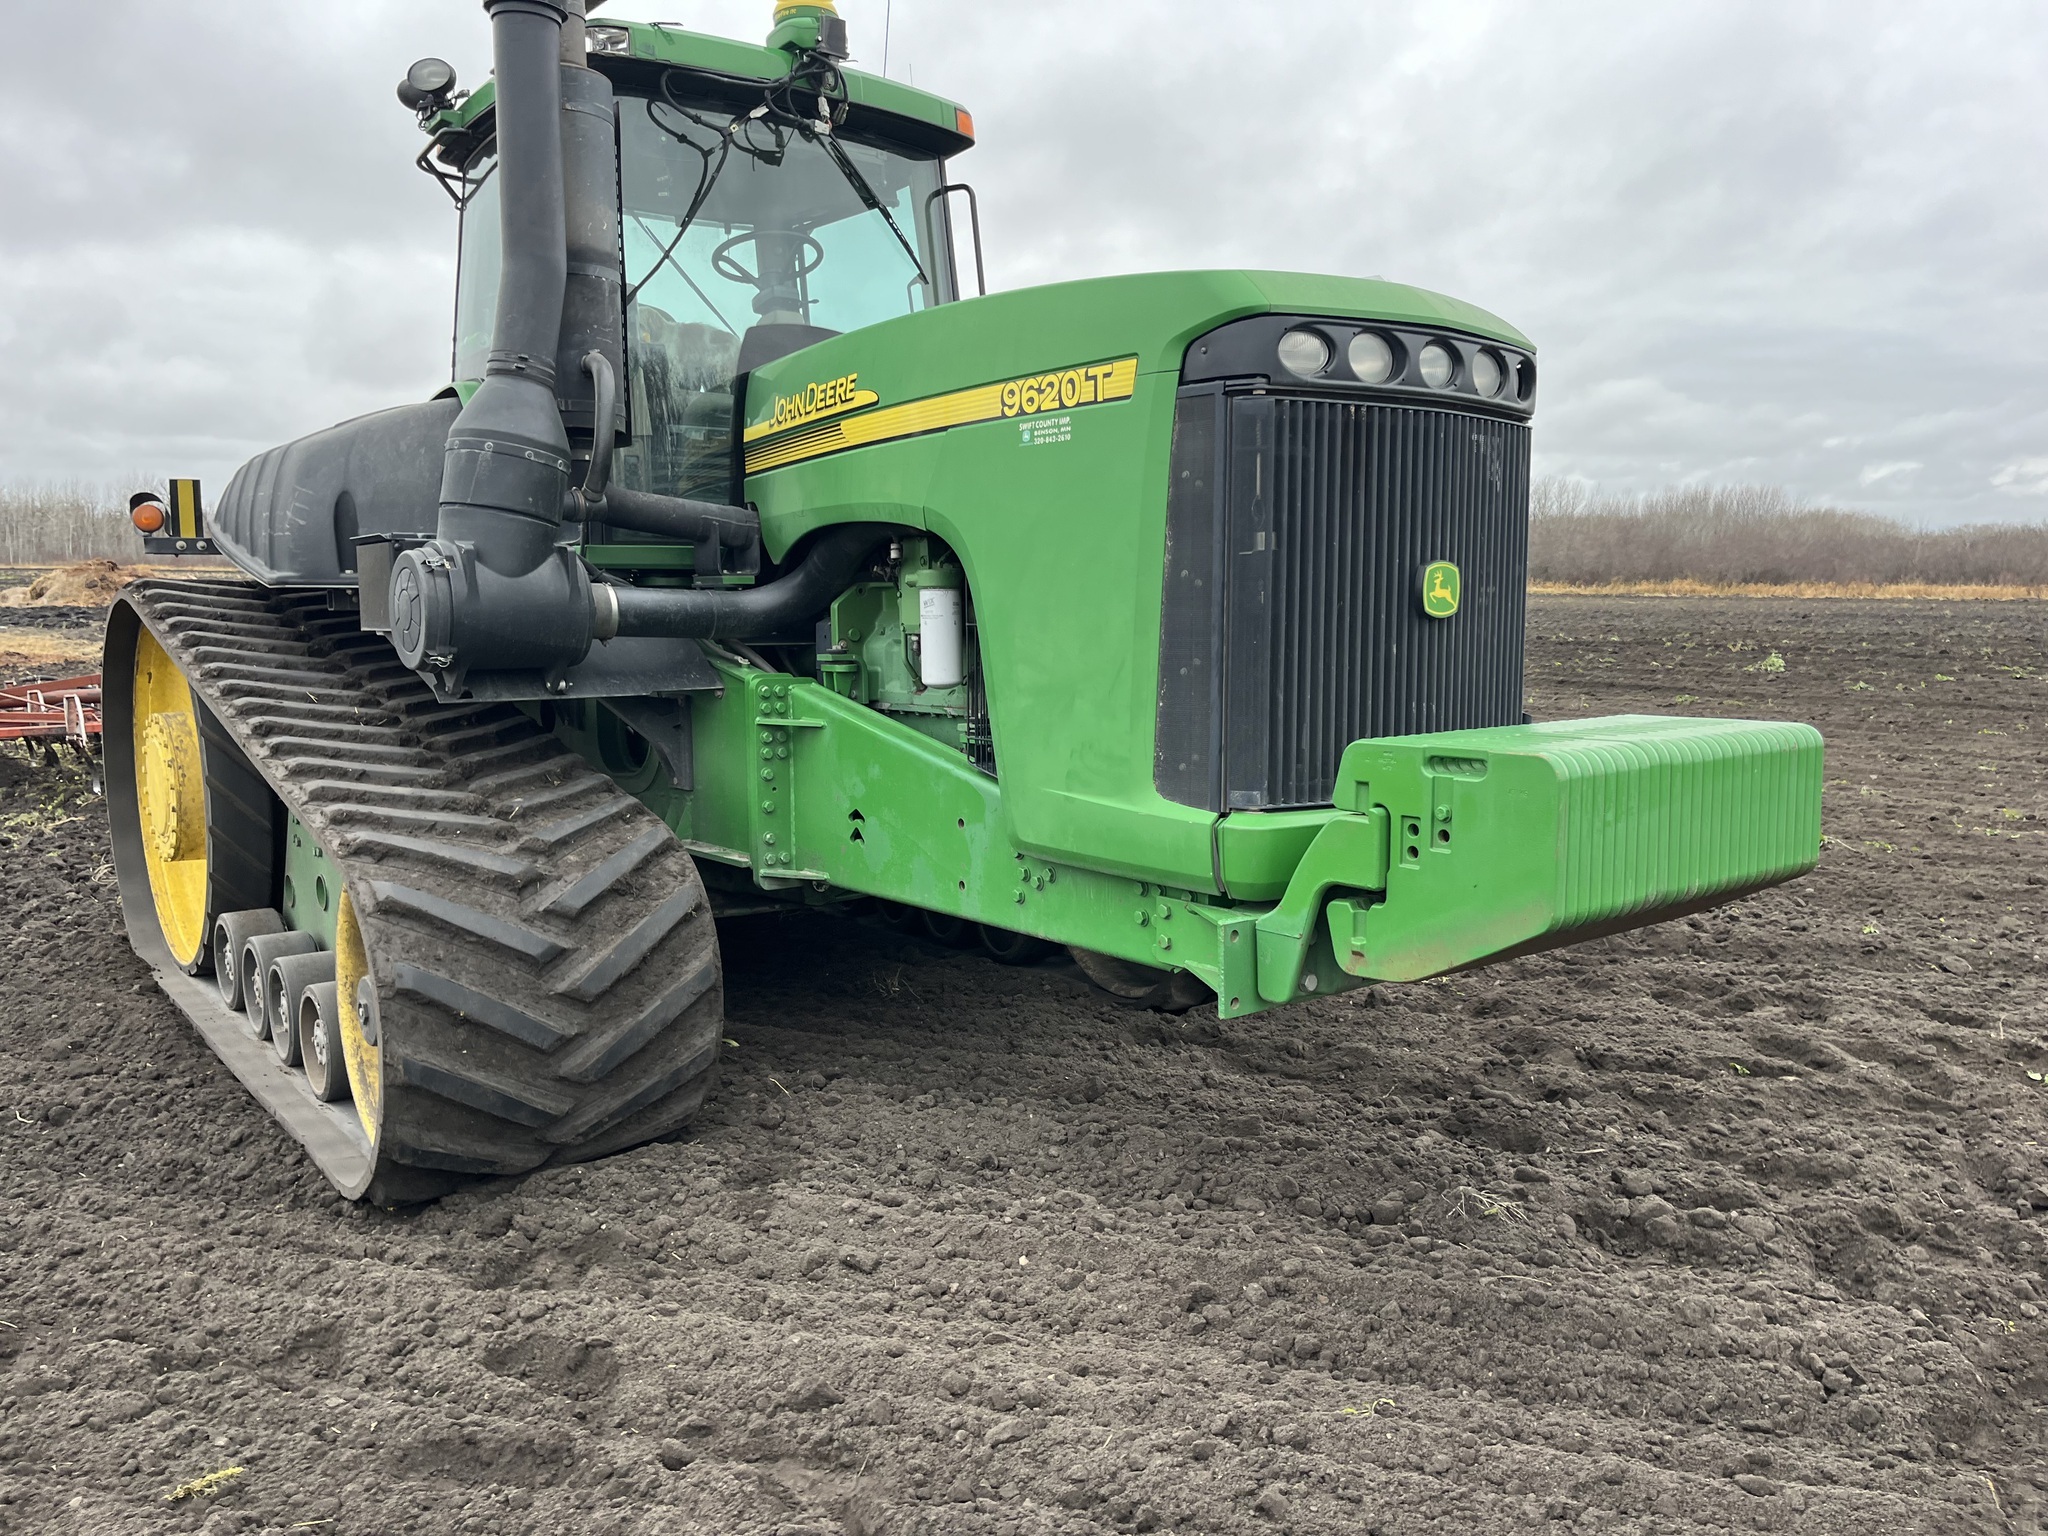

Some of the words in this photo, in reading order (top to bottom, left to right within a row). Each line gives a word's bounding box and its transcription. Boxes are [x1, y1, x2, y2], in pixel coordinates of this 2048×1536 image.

[769, 391, 806, 428] JOHN
[805, 373, 858, 414] DEERE
[1002, 363, 1113, 418] 9620T
[1019, 421, 1036, 431] SWIFT
[1035, 418, 1059, 429] COUNTY
